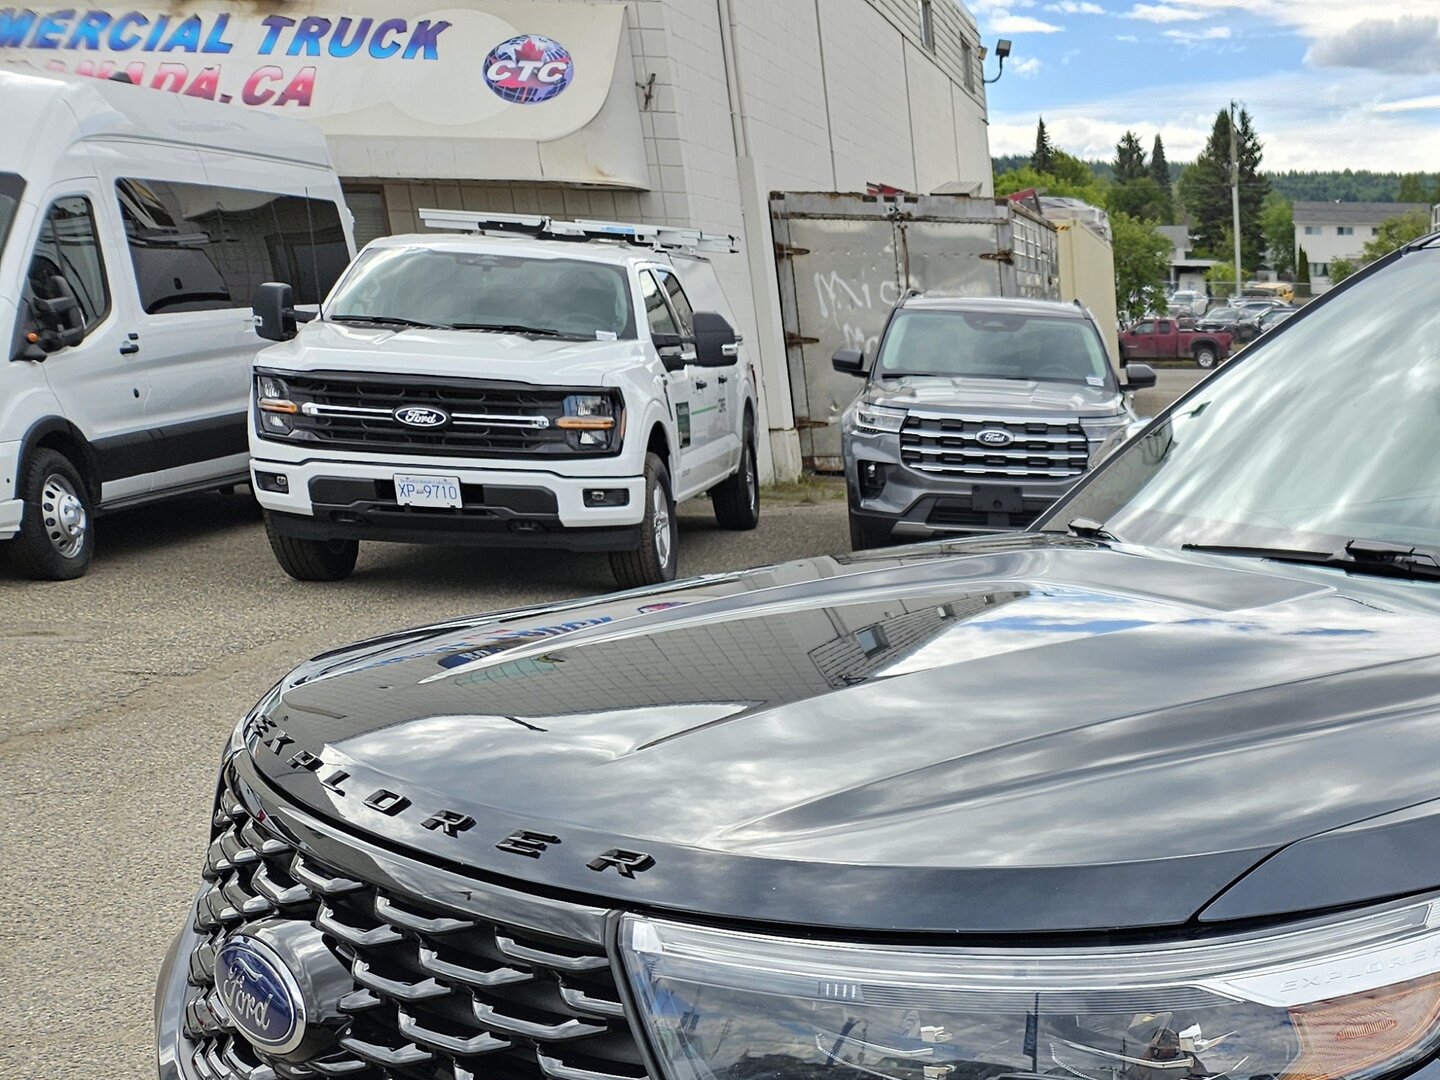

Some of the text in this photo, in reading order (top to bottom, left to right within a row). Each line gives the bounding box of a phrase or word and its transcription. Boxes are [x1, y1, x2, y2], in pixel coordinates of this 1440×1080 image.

[257, 14, 453, 60] TRUCK
[486, 59, 568, 84] CTC
[404, 409, 437, 424] Ford
[223, 956, 276, 1032] Ford
